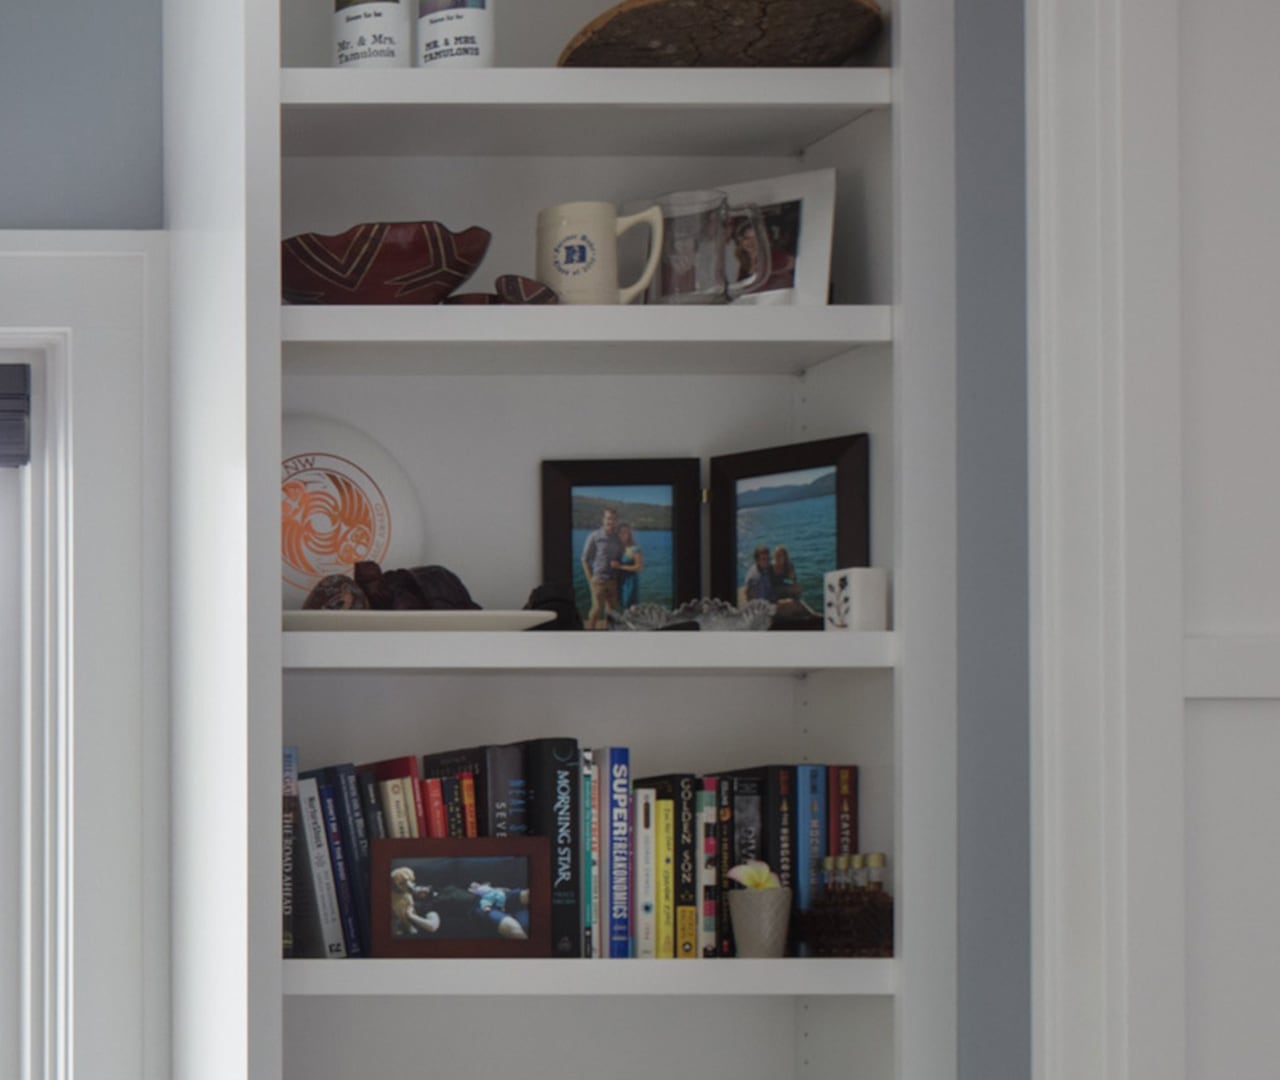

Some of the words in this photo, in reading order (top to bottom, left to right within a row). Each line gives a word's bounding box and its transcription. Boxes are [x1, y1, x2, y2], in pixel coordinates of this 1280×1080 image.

[508, 779, 527, 814] NEAL
[553, 770, 572, 845] MORNING
[680, 777, 693, 846] GOLDEN
[307, 797, 325, 849] NurtureShock
[612, 763, 629, 920] SUPERFREAKONOMICS
[840, 813, 852, 855] CATCH
[555, 845, 572, 889] STAR
[680, 850, 693, 885] SON
[283, 874, 293, 916] AHEAD
